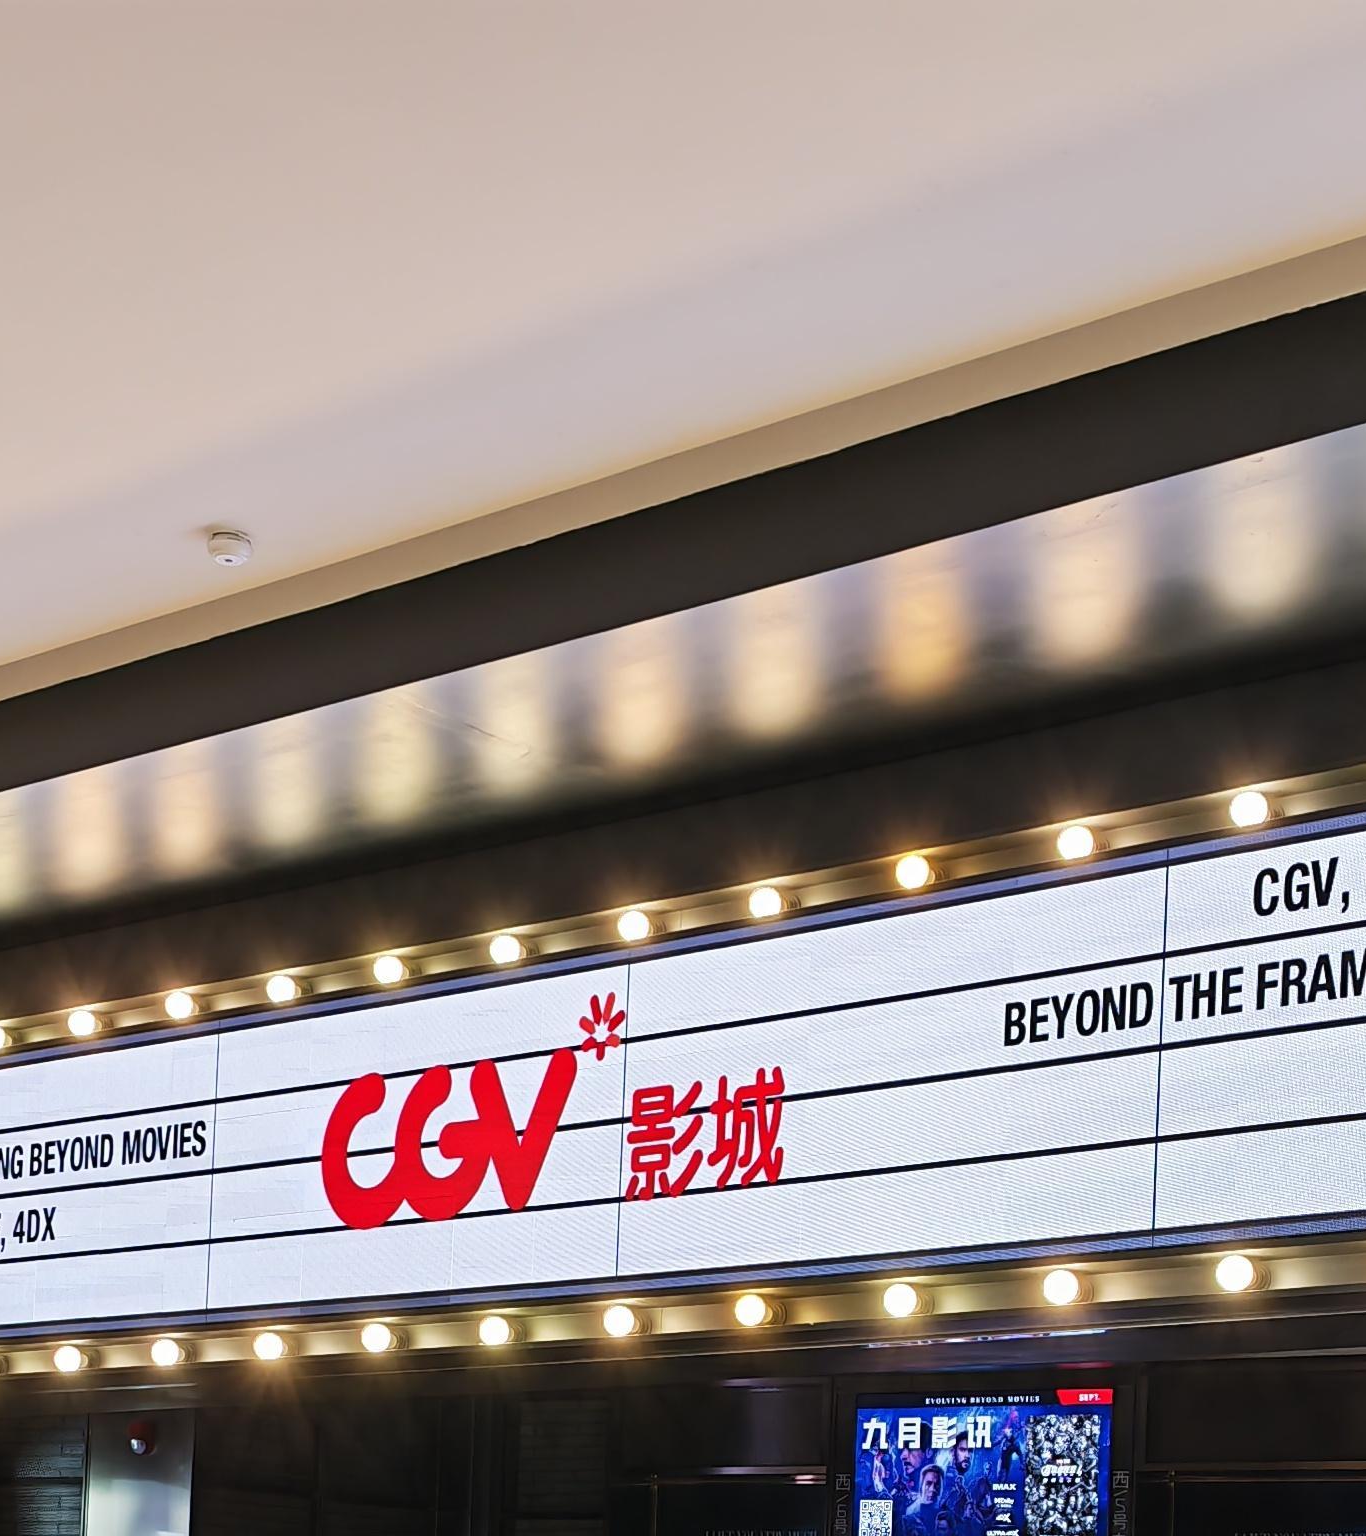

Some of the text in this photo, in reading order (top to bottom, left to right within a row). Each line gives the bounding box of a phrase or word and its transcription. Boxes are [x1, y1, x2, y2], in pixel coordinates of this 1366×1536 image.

[1254, 857, 1350, 916] CGV,
[1004, 982, 1154, 1046] BEYOND
[1169, 967, 1244, 1022] THE
[29, 1134, 114, 1177] BEYOND
[122, 1121, 207, 1165] MOVIES
[321, 1047, 578, 1230] CGV
[625, 1066, 785, 1201] 影城
[13, 1207, 57, 1244] 4DX
[861, 1415, 993, 1450] 九月影讯
[992, 1483, 1017, 1491] IMAX
